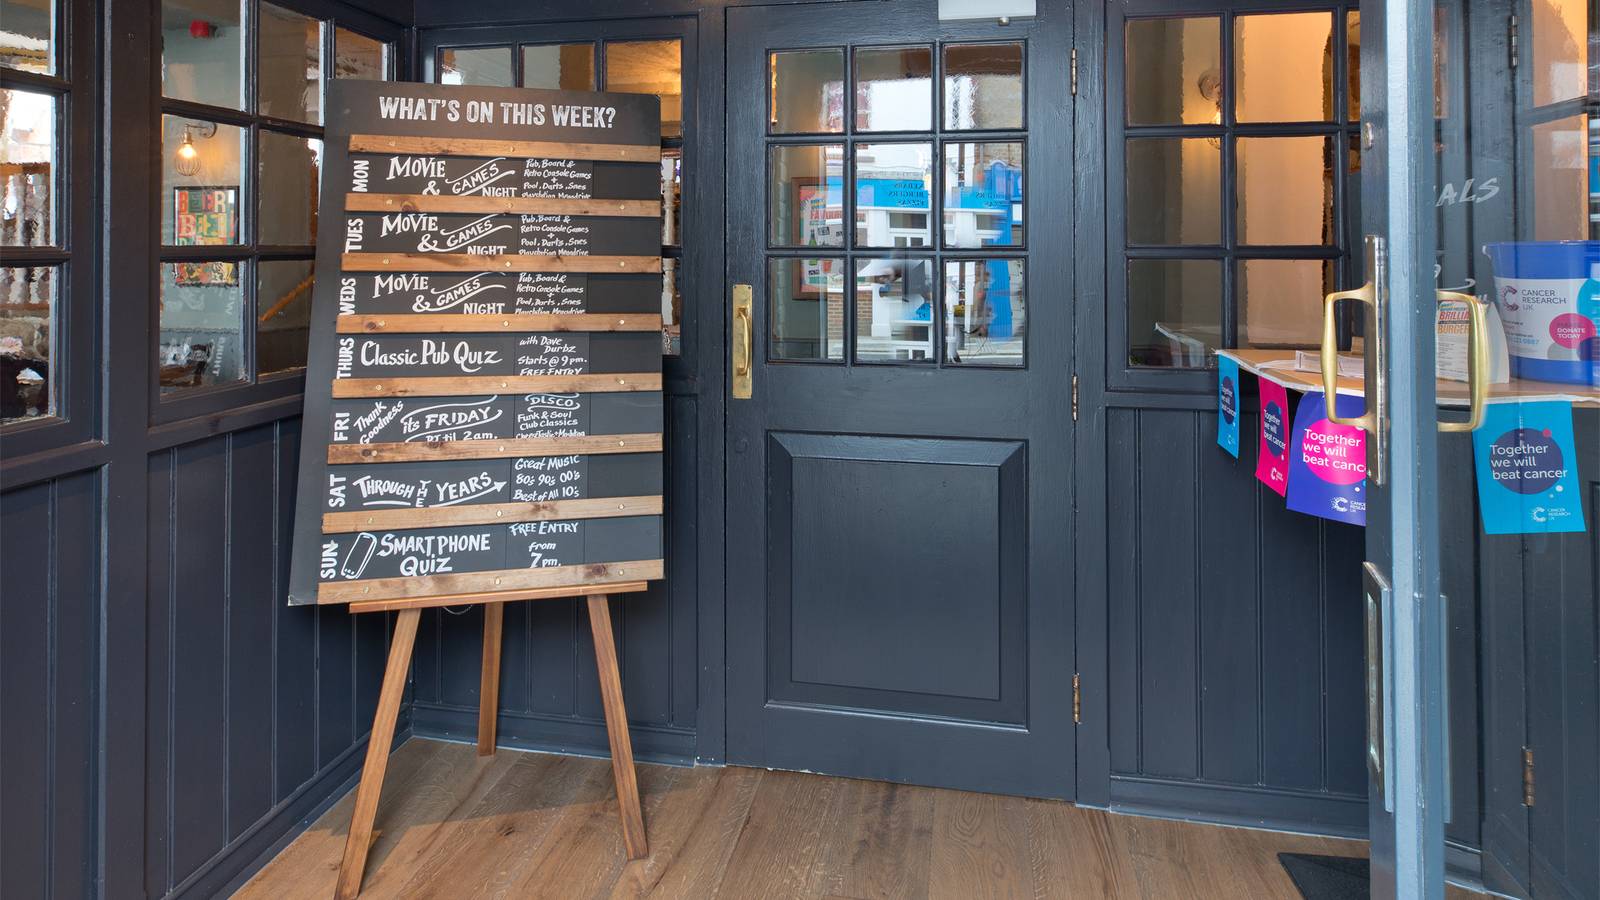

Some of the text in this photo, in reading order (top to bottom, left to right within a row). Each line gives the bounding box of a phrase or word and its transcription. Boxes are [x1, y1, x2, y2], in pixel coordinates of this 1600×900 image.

[379, 96, 617, 129] WHAT'S ON THIS WEEK?
[386, 156, 446, 181] MOVIE
[541, 159, 566, 169] Board
[567, 160, 576, 169] &
[351, 159, 370, 193] MON
[421, 162, 500, 196] & GAMES
[523, 168, 592, 180] Retro Console Games
[482, 186, 518, 198] NIGHT
[380, 213, 439, 238] MOVIE
[563, 215, 571, 224] &
[344, 218, 364, 253] TUES
[417, 219, 494, 252] & GAMES
[520, 224, 589, 234] Retro Console Games
[467, 245, 507, 255] NIGHT
[535, 273, 560, 282] Board
[558, 274, 567, 283] &
[372, 273, 428, 298] MOVIE
[516, 283, 584, 293] Retro Console Games
[339, 278, 356, 315] WEDS
[412, 279, 481, 312] & GAMES
[1521, 289, 1556, 297] CANCER
[463, 302, 505, 314] NIGHT
[1522, 297, 1567, 305] RESEARCH
[519, 336, 563, 345] with Dave
[336, 337, 355, 379] THURS
[360, 340, 419, 367] Classic
[420, 339, 450, 365] Pub
[517, 355, 548, 365] Starts
[520, 367, 583, 376] FREE ENTRY
[530, 395, 574, 407] DISCO
[353, 400, 387, 433] Thank
[359, 400, 404, 445] Goodness
[425, 406, 491, 430] FRIDAY
[517, 410, 572, 422] Funk & Soul
[333, 412, 350, 441] FRI
[519, 418, 579, 431] Club Classics
[1304, 428, 1361, 447] Together
[1303, 443, 1347, 458] we will
[1489, 444, 1549, 457] Together
[514, 457, 546, 470] Great
[1302, 453, 1366, 473] beat canc
[1491, 456, 1536, 468] we will
[1492, 469, 1568, 480] beat cancer
[328, 474, 347, 508] SAT
[352, 475, 416, 499] THROUGH
[436, 472, 493, 502] YEARS
[513, 489, 537, 502] Best
[537, 491, 548, 502] of
[547, 489, 559, 500] All
[508, 521, 579, 537] FREE ENTRY
[528, 541, 557, 552] from
[320, 543, 339, 579] SUN
